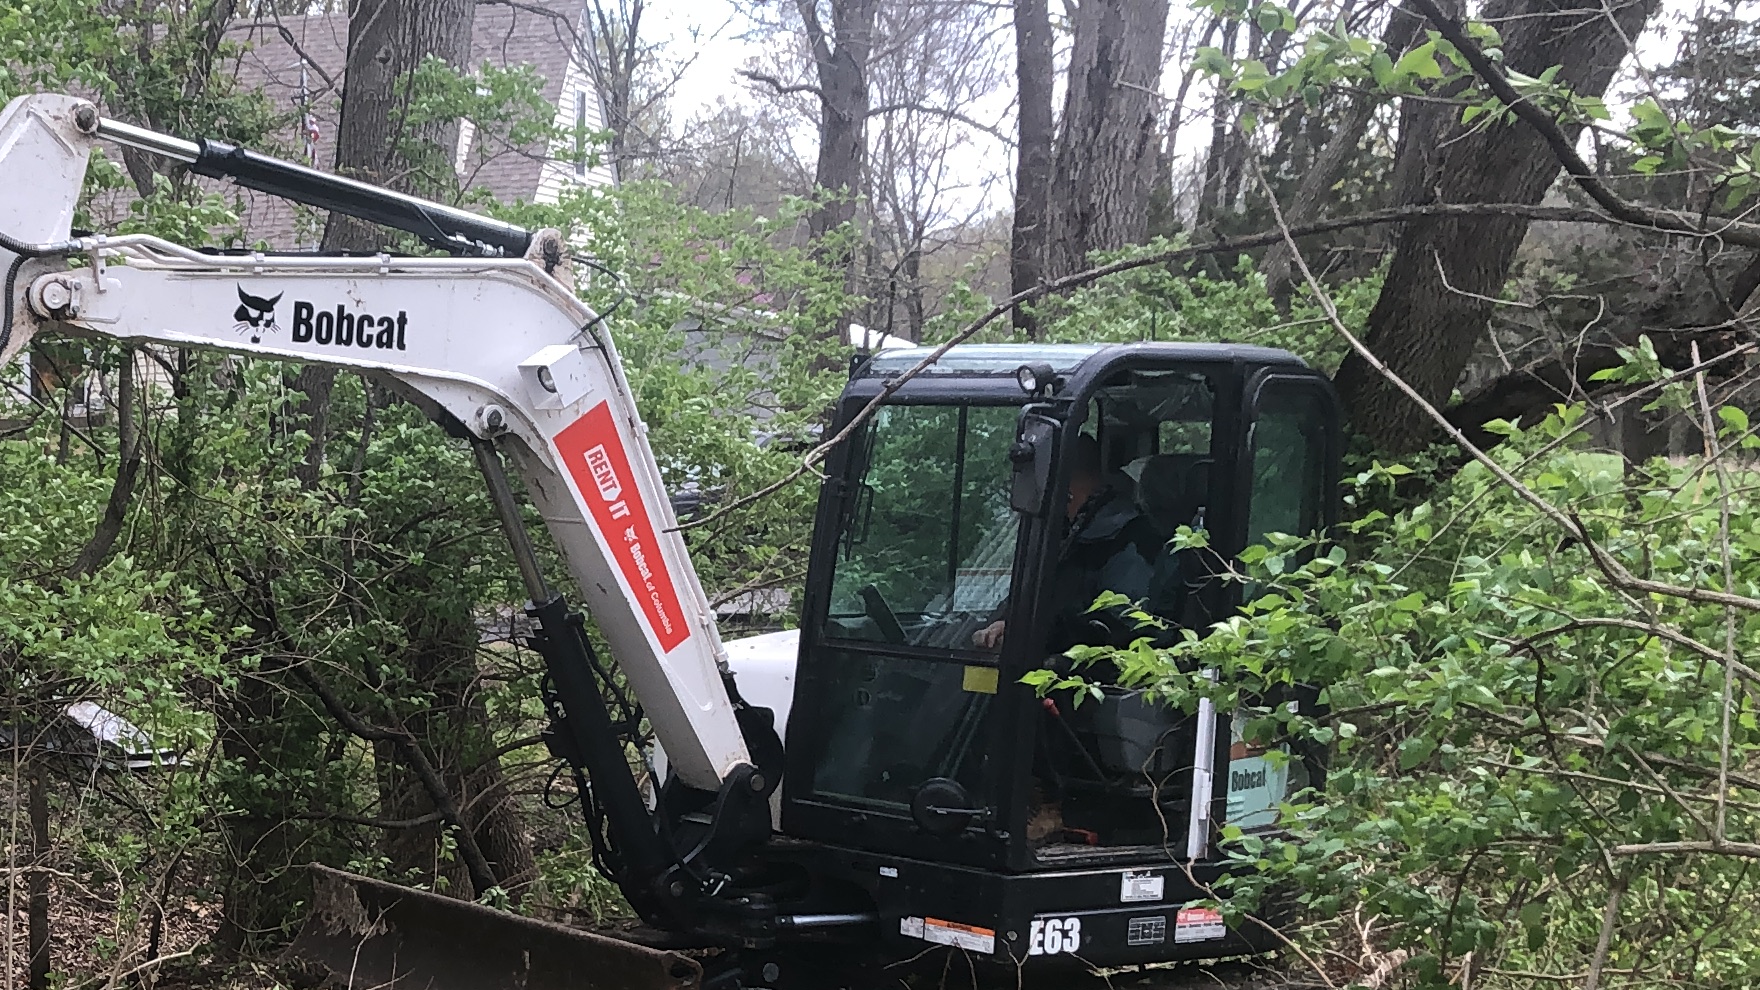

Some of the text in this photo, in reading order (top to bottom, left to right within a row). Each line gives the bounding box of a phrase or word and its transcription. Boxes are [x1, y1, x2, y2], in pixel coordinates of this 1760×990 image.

[291, 300, 408, 351] Bobcat
[588, 449, 631, 520] RENT IT
[630, 542, 653, 583] Bobcat
[1231, 769, 1266, 792] Bobcat
[1029, 917, 1082, 956] E63
